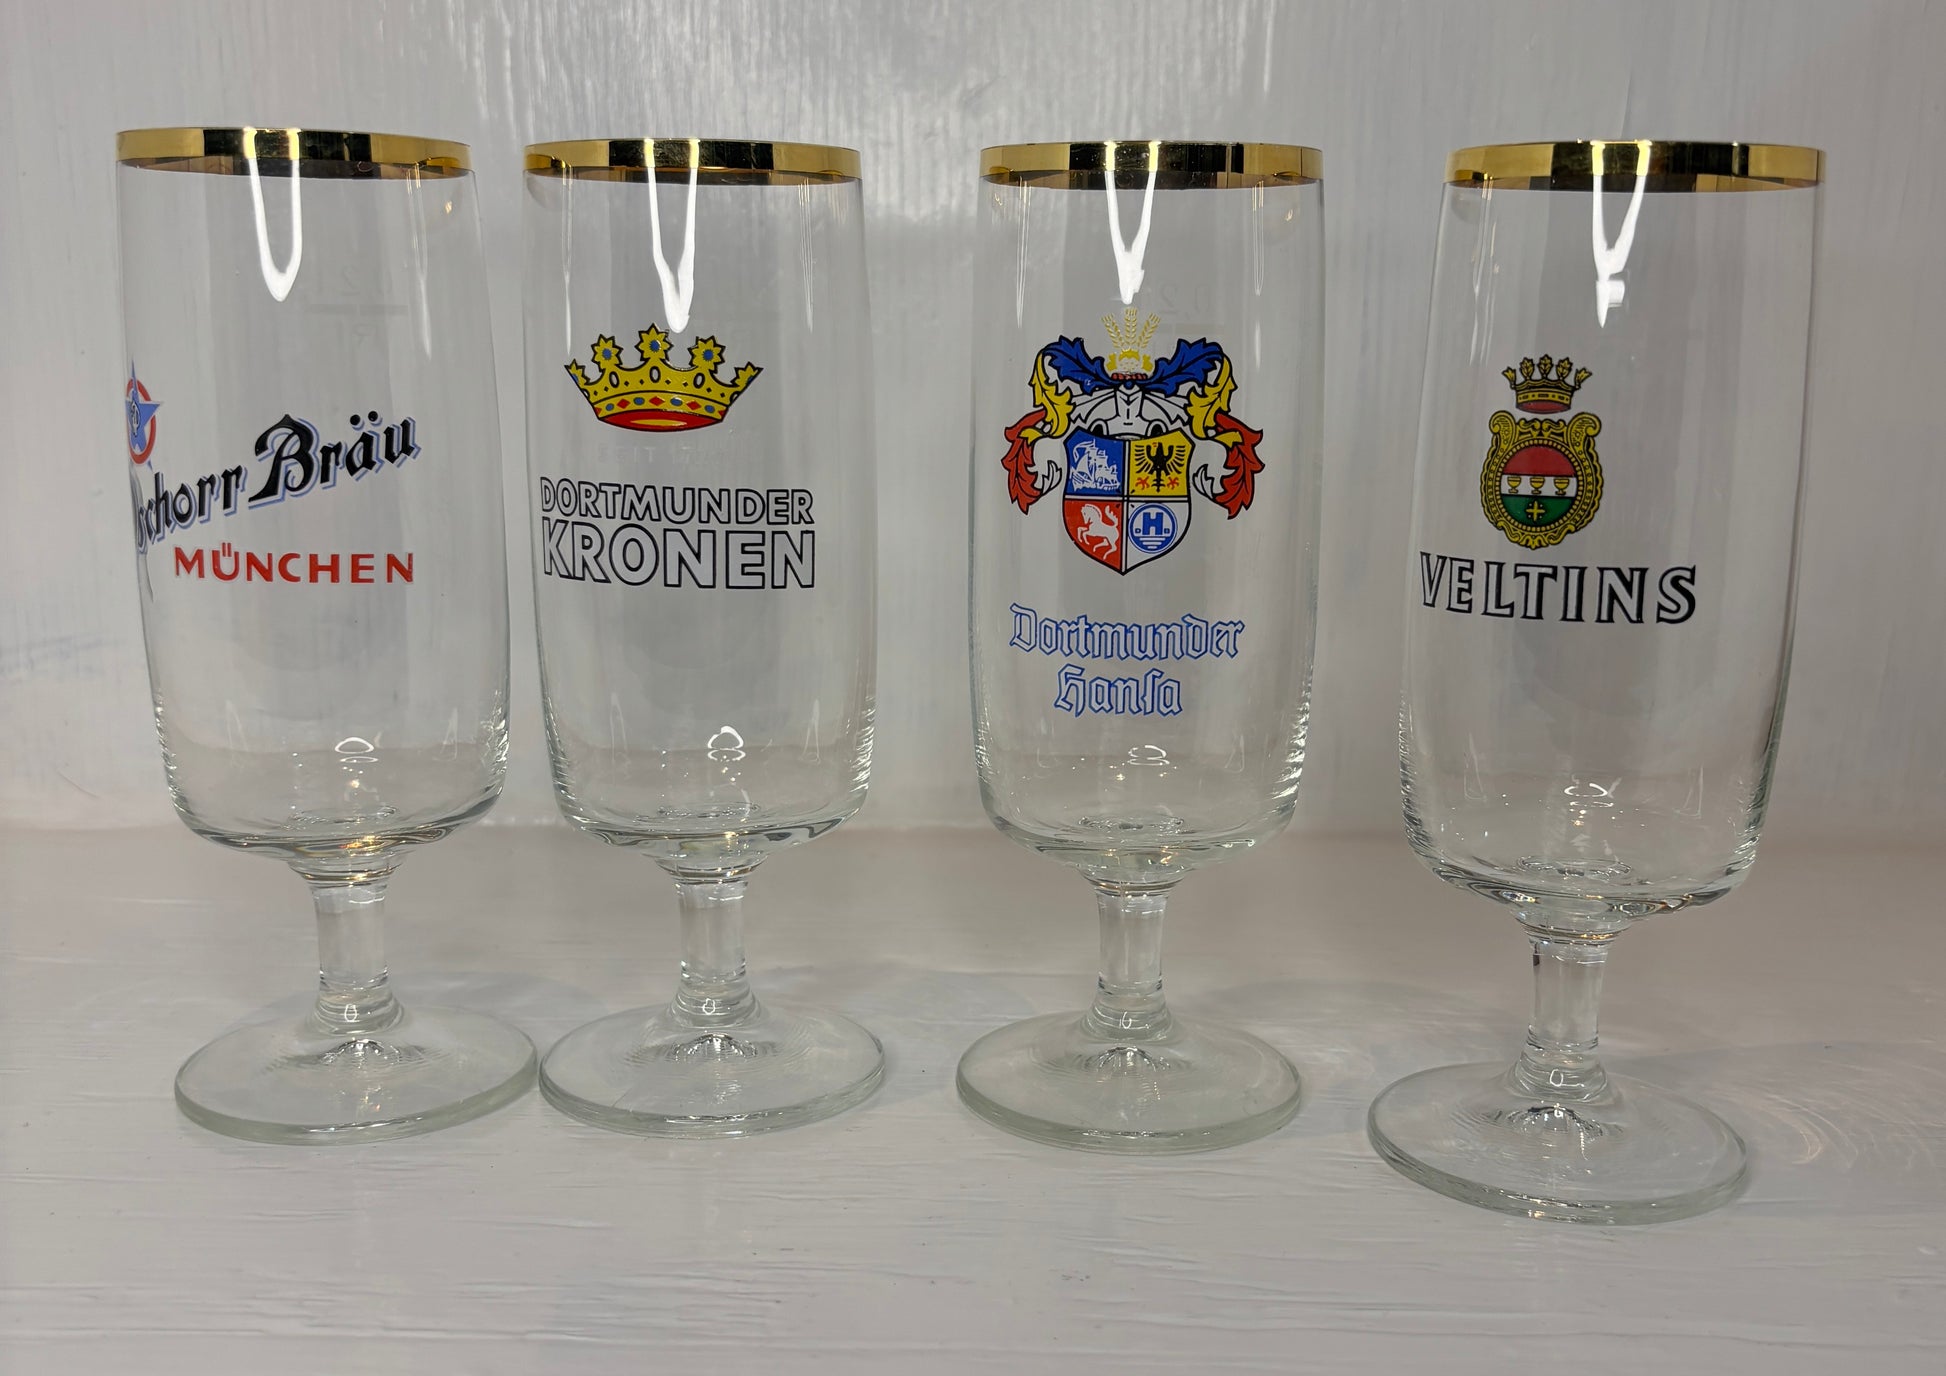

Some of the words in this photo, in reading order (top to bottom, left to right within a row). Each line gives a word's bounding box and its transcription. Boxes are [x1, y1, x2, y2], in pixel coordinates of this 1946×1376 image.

[248, 410, 421, 509] Bräu
[540, 477, 814, 525] DORTMUNDER
[1142, 512, 1164, 535] H
[174, 542, 414, 583] MÜNCHEN
[541, 517, 815, 589] KRONEN
[1419, 551, 1696, 624] VELTINS
[1009, 602, 1246, 661] Dortmunder
